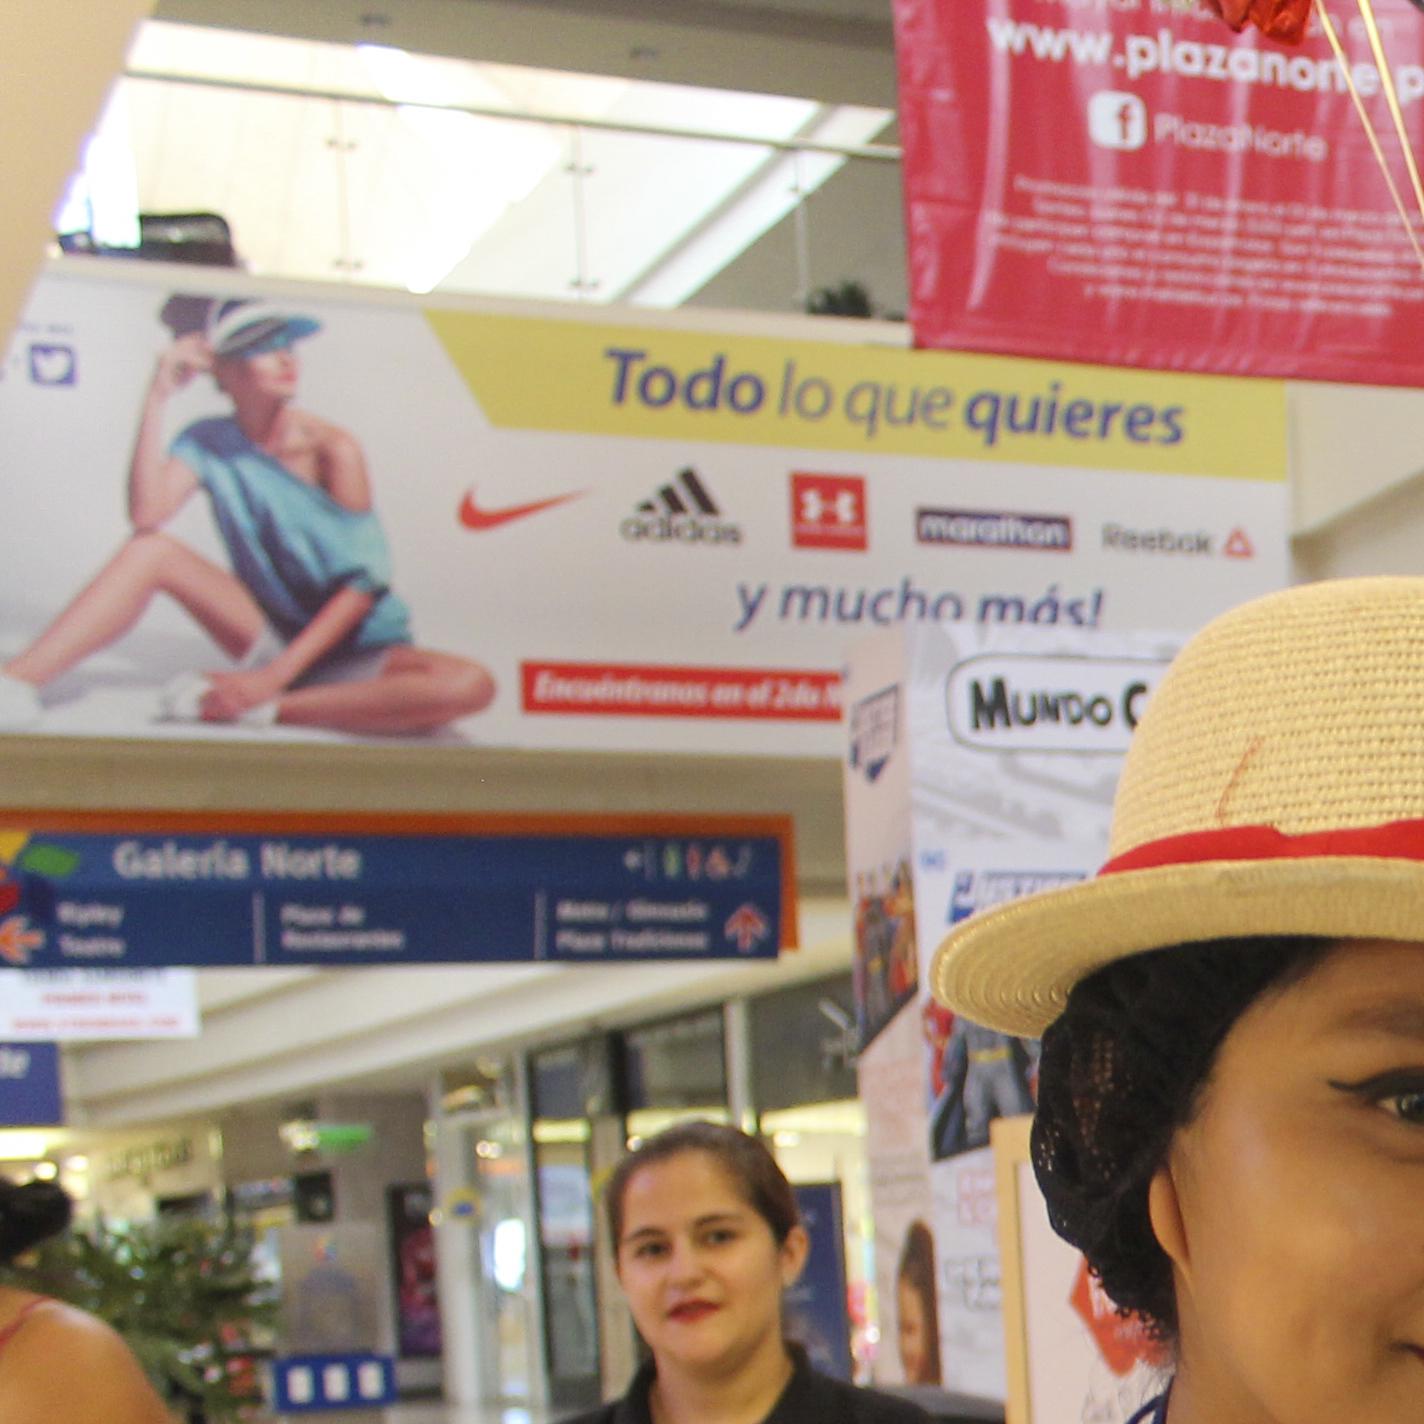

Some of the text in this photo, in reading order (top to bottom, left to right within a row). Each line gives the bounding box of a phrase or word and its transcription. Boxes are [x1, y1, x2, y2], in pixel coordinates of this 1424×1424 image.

[606, 348, 1185, 447] Todo lo que quieres
[620, 516, 743, 545] adidas
[733, 576, 1106, 634] y mucho más!
[260, 841, 363, 881] Norte
